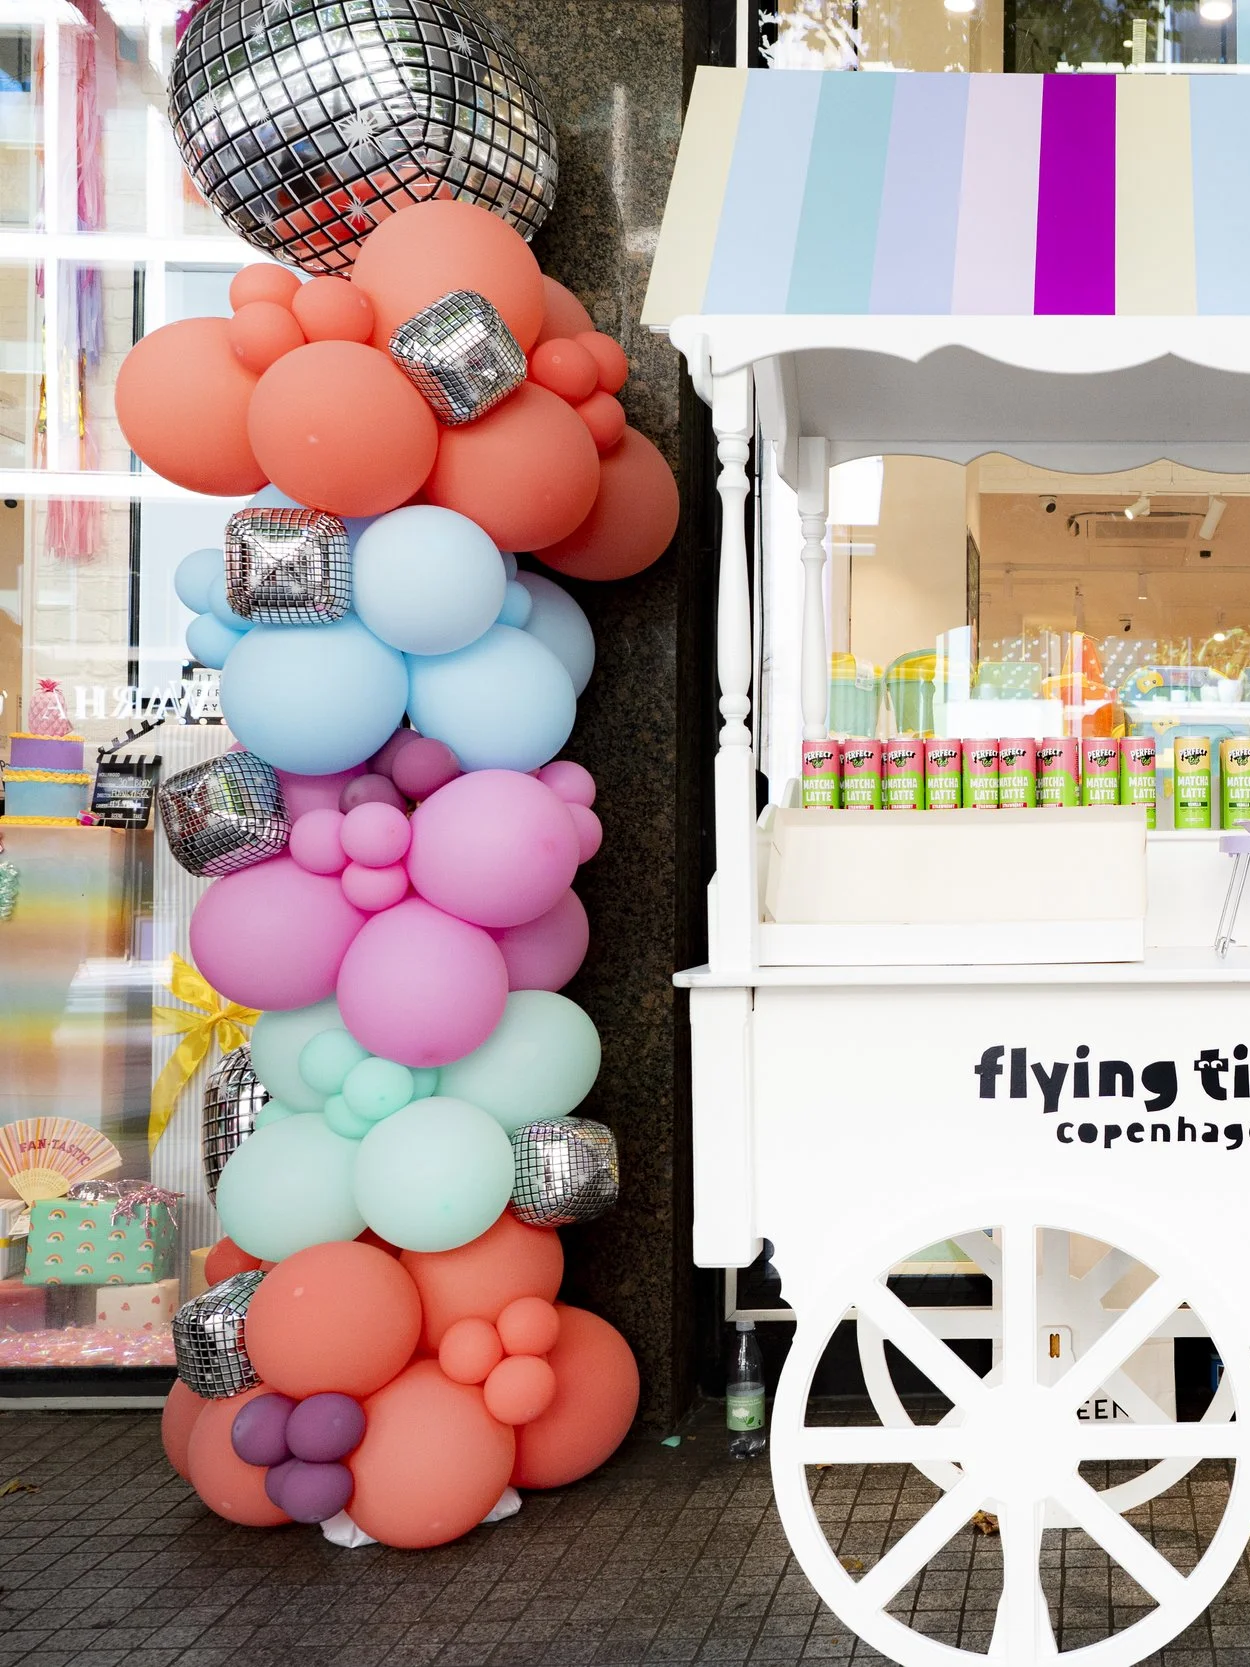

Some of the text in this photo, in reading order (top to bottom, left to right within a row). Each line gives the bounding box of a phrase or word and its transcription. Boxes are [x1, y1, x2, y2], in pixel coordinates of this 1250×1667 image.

[804, 750, 832, 761] PERFECT
[845, 749, 873, 761] PERFECT
[889, 749, 915, 761] PERFECT
[928, 749, 956, 761] PERFECT
[1000, 748, 1025, 760] PERFECT
[1088, 748, 1116, 760] PERFECT
[804, 779, 834, 789] MATCHA
[844, 778, 875, 789] MATCHA
[887, 778, 917, 788] MATCHA
[928, 778, 958, 788] MATCHA
[1087, 778, 1117, 788] MATCHA
[1178, 776, 1208, 786] MATCHA
[806, 791, 831, 801] LATTE
[847, 791, 872, 801] LATTE
[890, 790, 914, 801] LATTE
[931, 790, 956, 801] LATTE
[1001, 789, 1024, 799] LATTE
[1090, 790, 1115, 800] LATTE
[1181, 788, 1206, 798] LATTE
[974, 1044, 1178, 1114] flying
